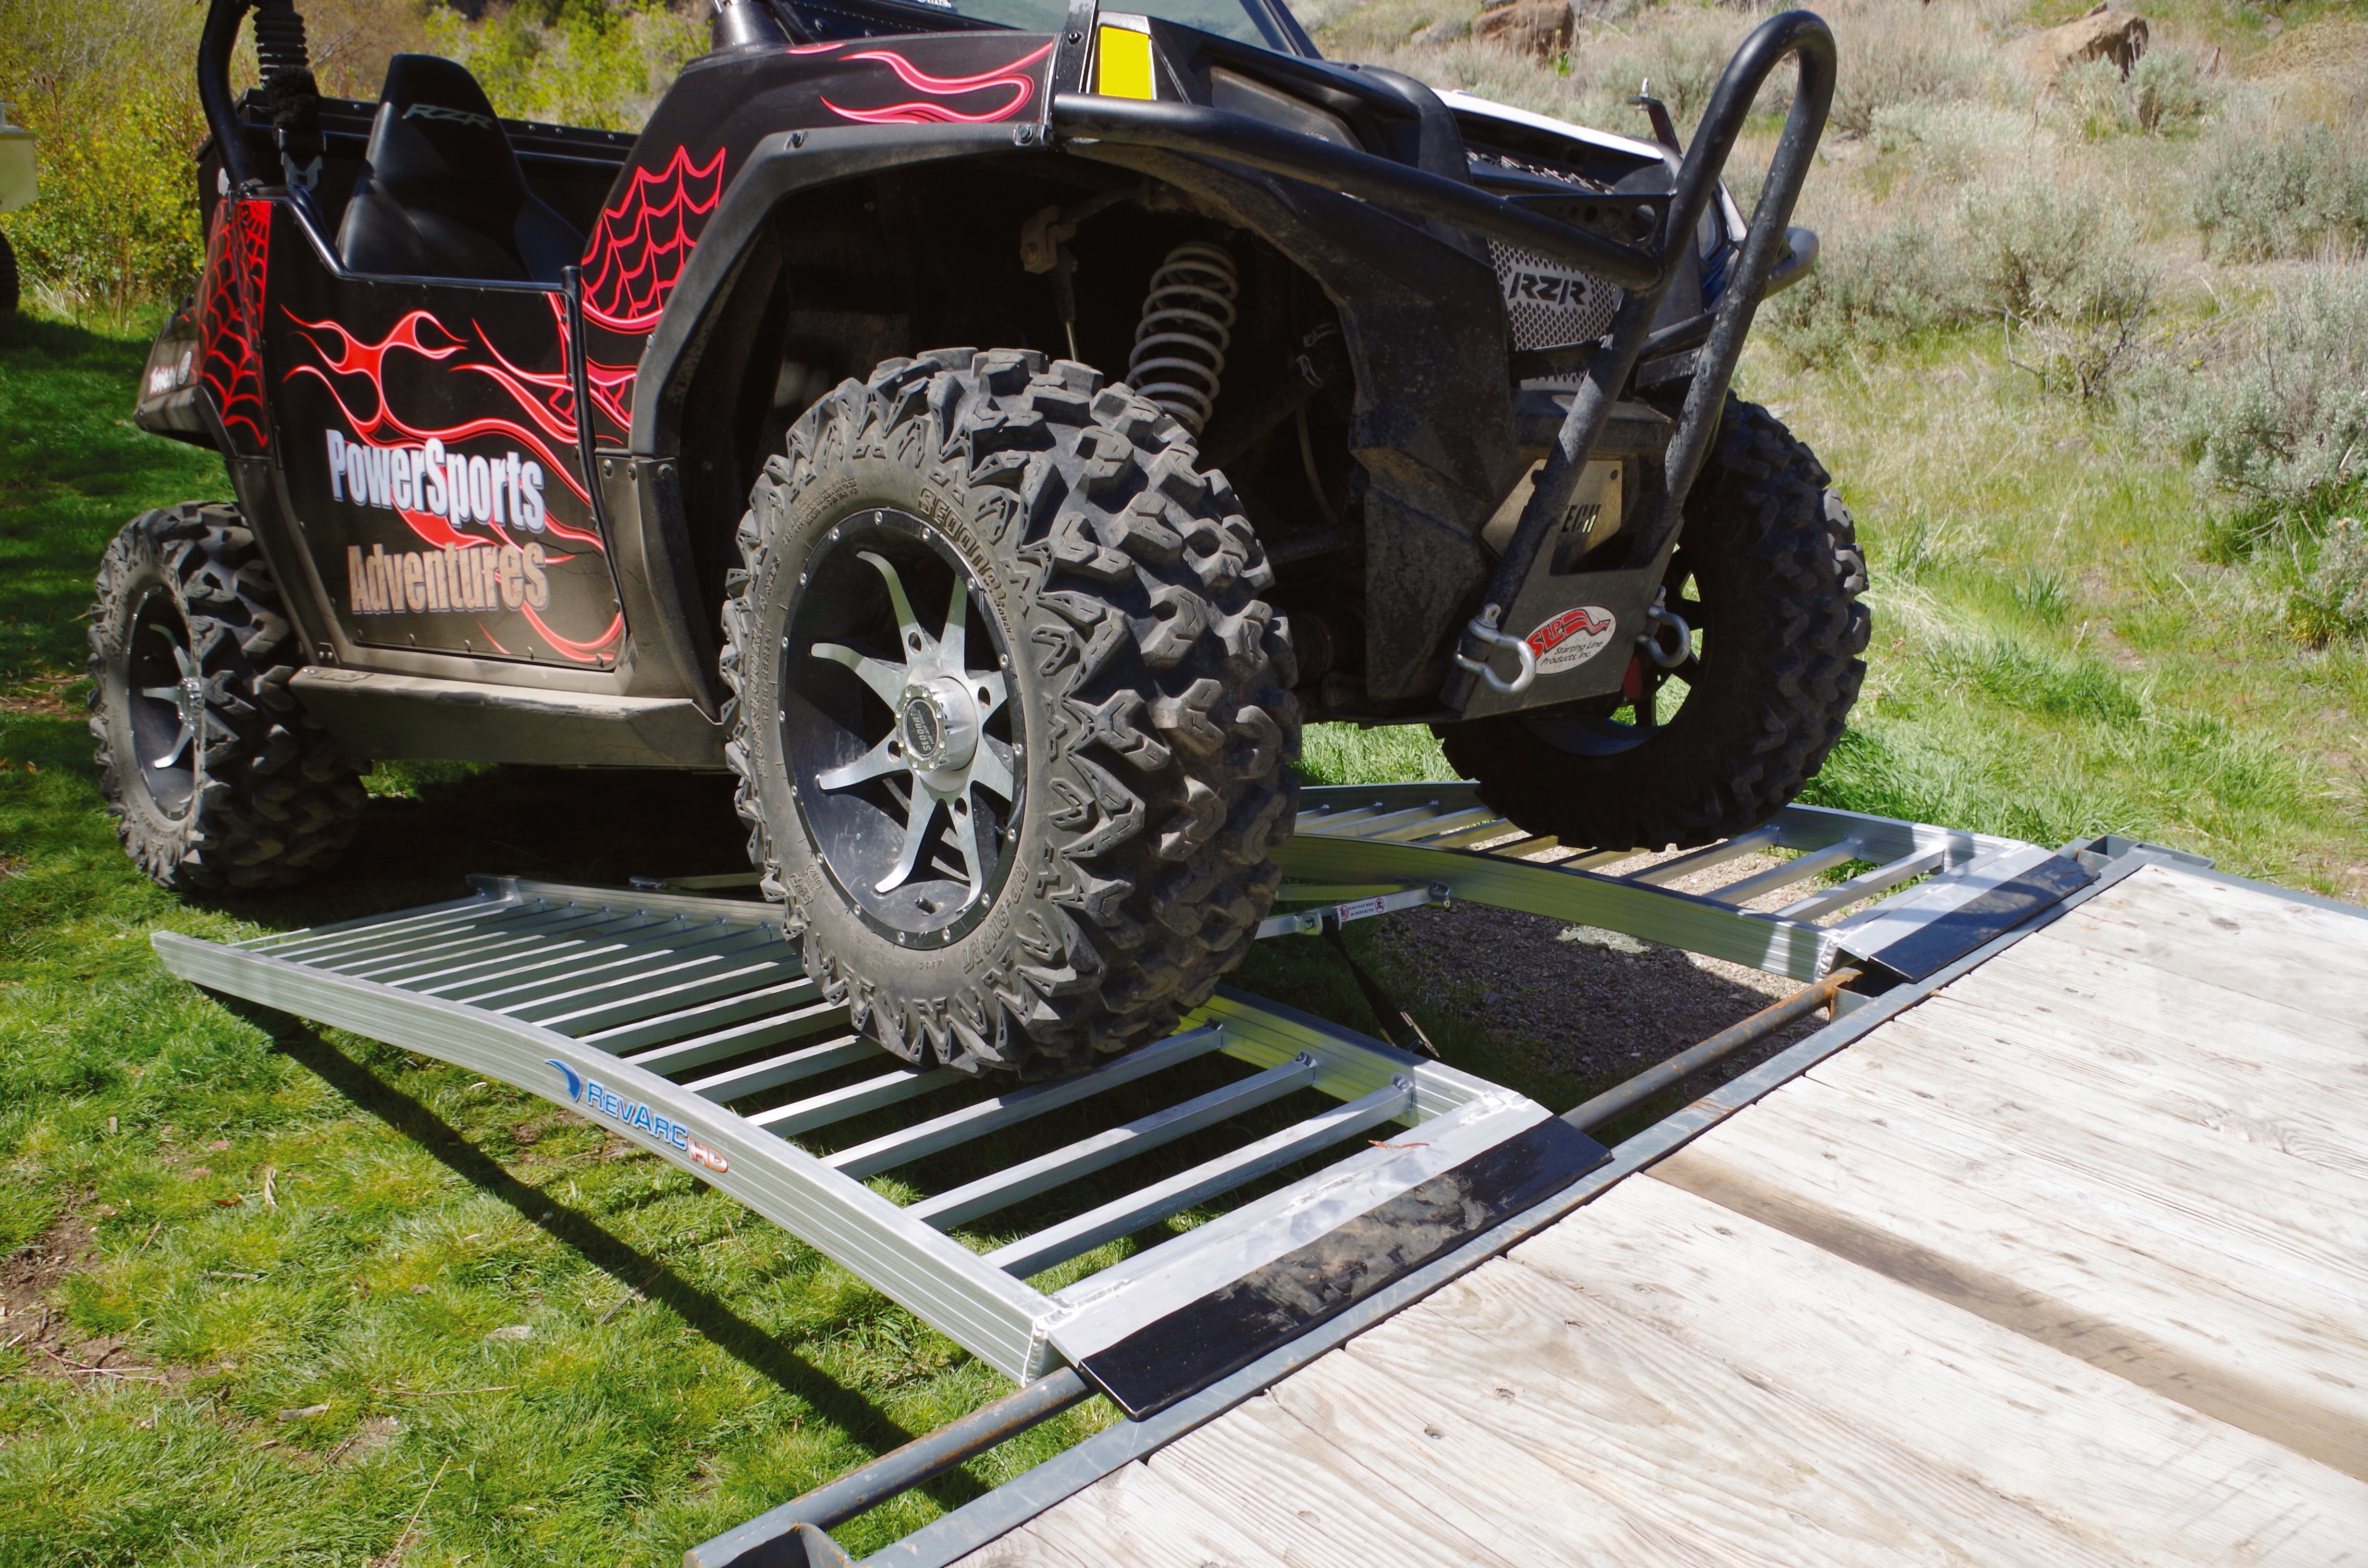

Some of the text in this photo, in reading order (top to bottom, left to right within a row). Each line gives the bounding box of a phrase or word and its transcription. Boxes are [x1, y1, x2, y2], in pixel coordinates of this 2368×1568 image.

[402, 103, 493, 130] RZR
[1508, 272, 1586, 306] RZR
[326, 429, 546, 534] PowerSports
[1561, 504, 1602, 533] ECH
[347, 541, 550, 615] Adventures
[1554, 641, 1603, 655] Starting Line
[913, 717, 932, 751] SEDONA
[687, 1138, 728, 1172] HD
